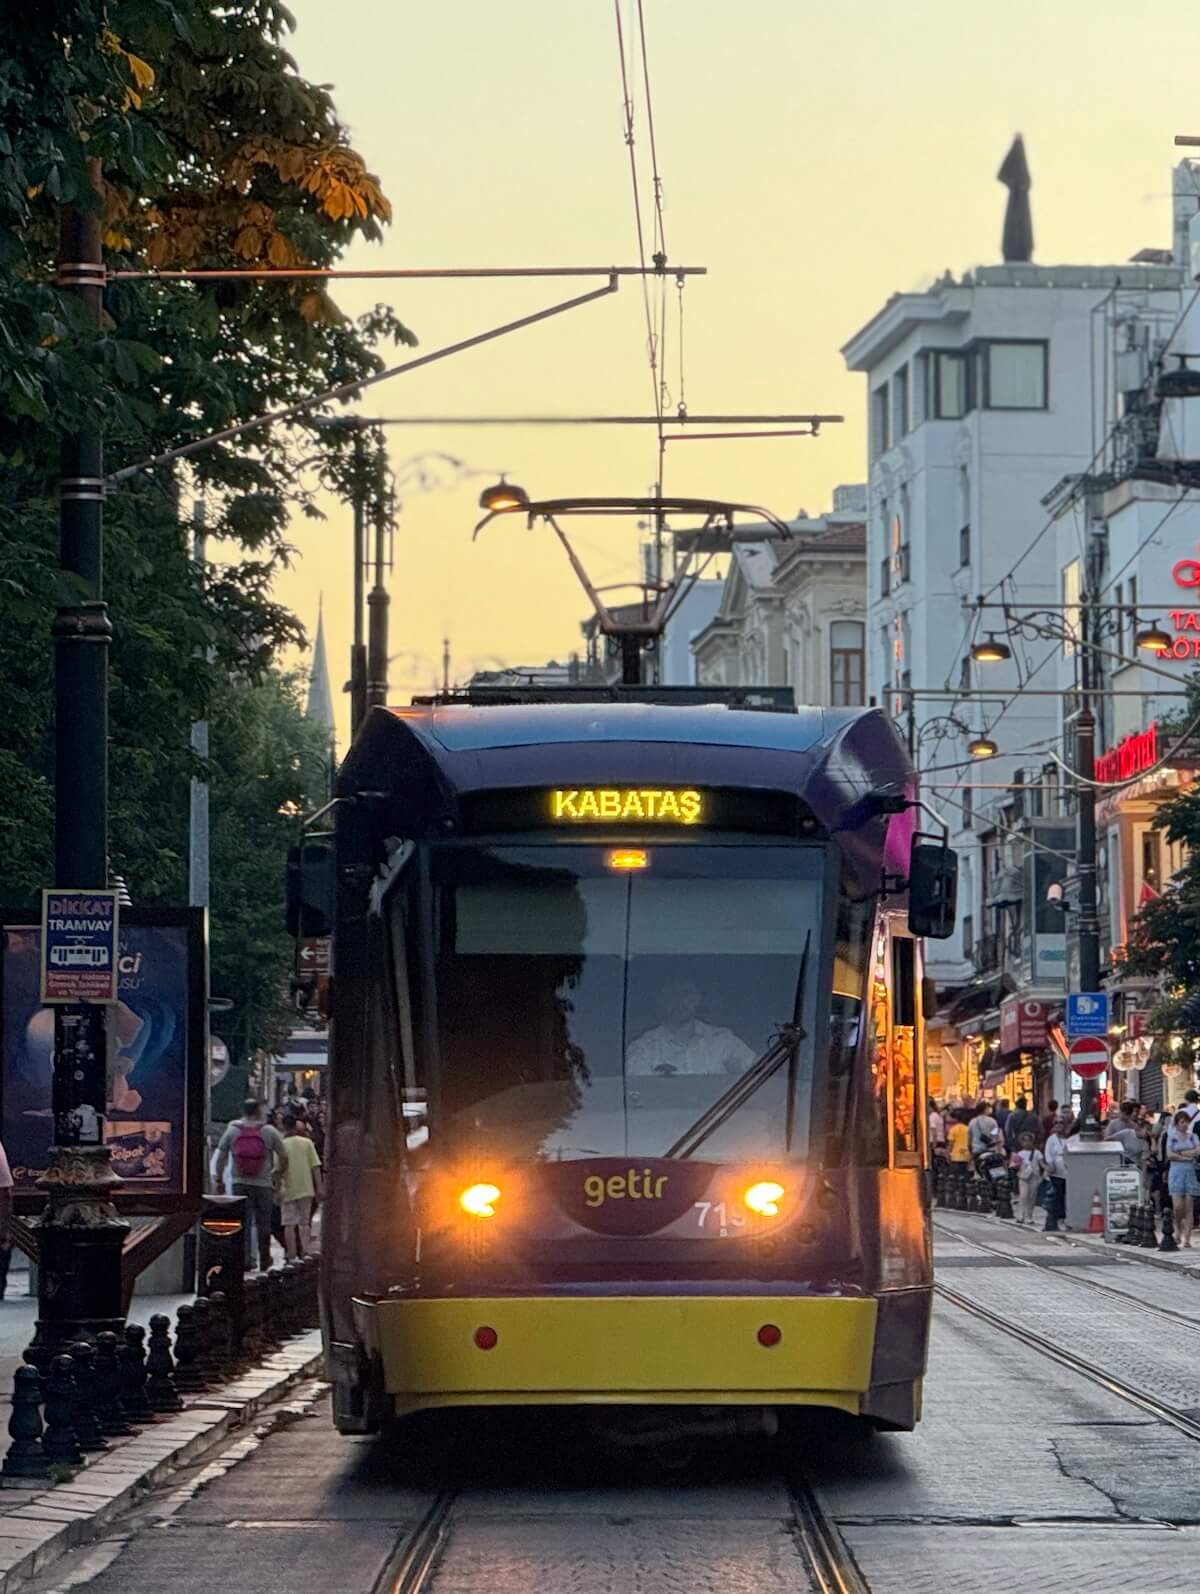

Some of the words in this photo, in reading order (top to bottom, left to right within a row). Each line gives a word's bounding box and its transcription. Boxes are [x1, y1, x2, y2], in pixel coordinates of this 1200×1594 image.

[555, 790, 701, 824] KABATAŞ
[49, 898, 113, 915] DİKKAT
[48, 919, 112, 931] TRAMVAY
[110, 1145, 145, 1162] Selpak
[584, 1168, 669, 1207] getir
